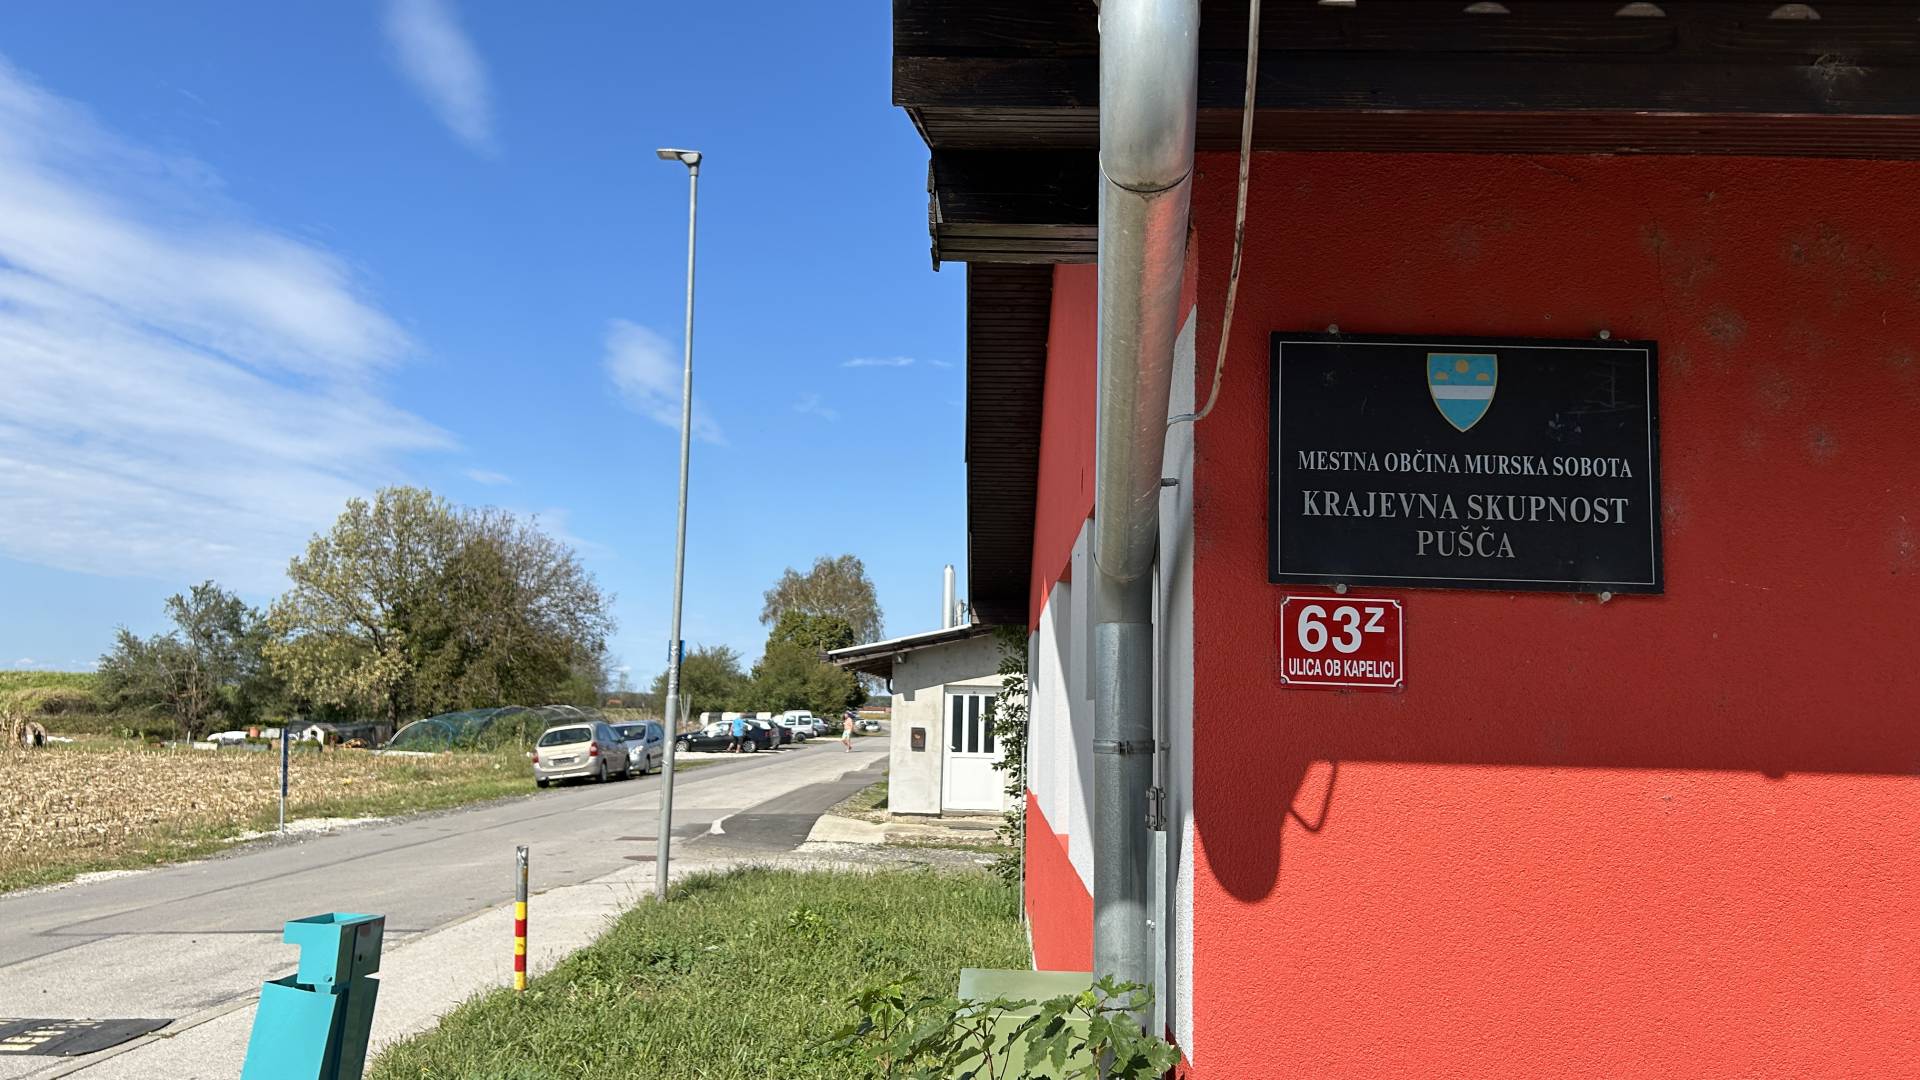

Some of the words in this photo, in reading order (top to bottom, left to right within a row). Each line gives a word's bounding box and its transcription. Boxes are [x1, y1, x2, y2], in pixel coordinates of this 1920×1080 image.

[1298, 450, 1380, 472] MESTNA
[1384, 449, 1460, 474] OBČINA
[1464, 454, 1549, 476] MURSKA
[1552, 456, 1633, 478] SOBOTA
[1302, 490, 1459, 520] KRAJEVNA
[1467, 494, 1629, 524] SKUPNOST
[1416, 525, 1515, 558] PUŠČA
[1288, 657, 1323, 676] ULICA
[1324, 658, 1342, 677] OB
[1343, 659, 1395, 679] KAPELICI
